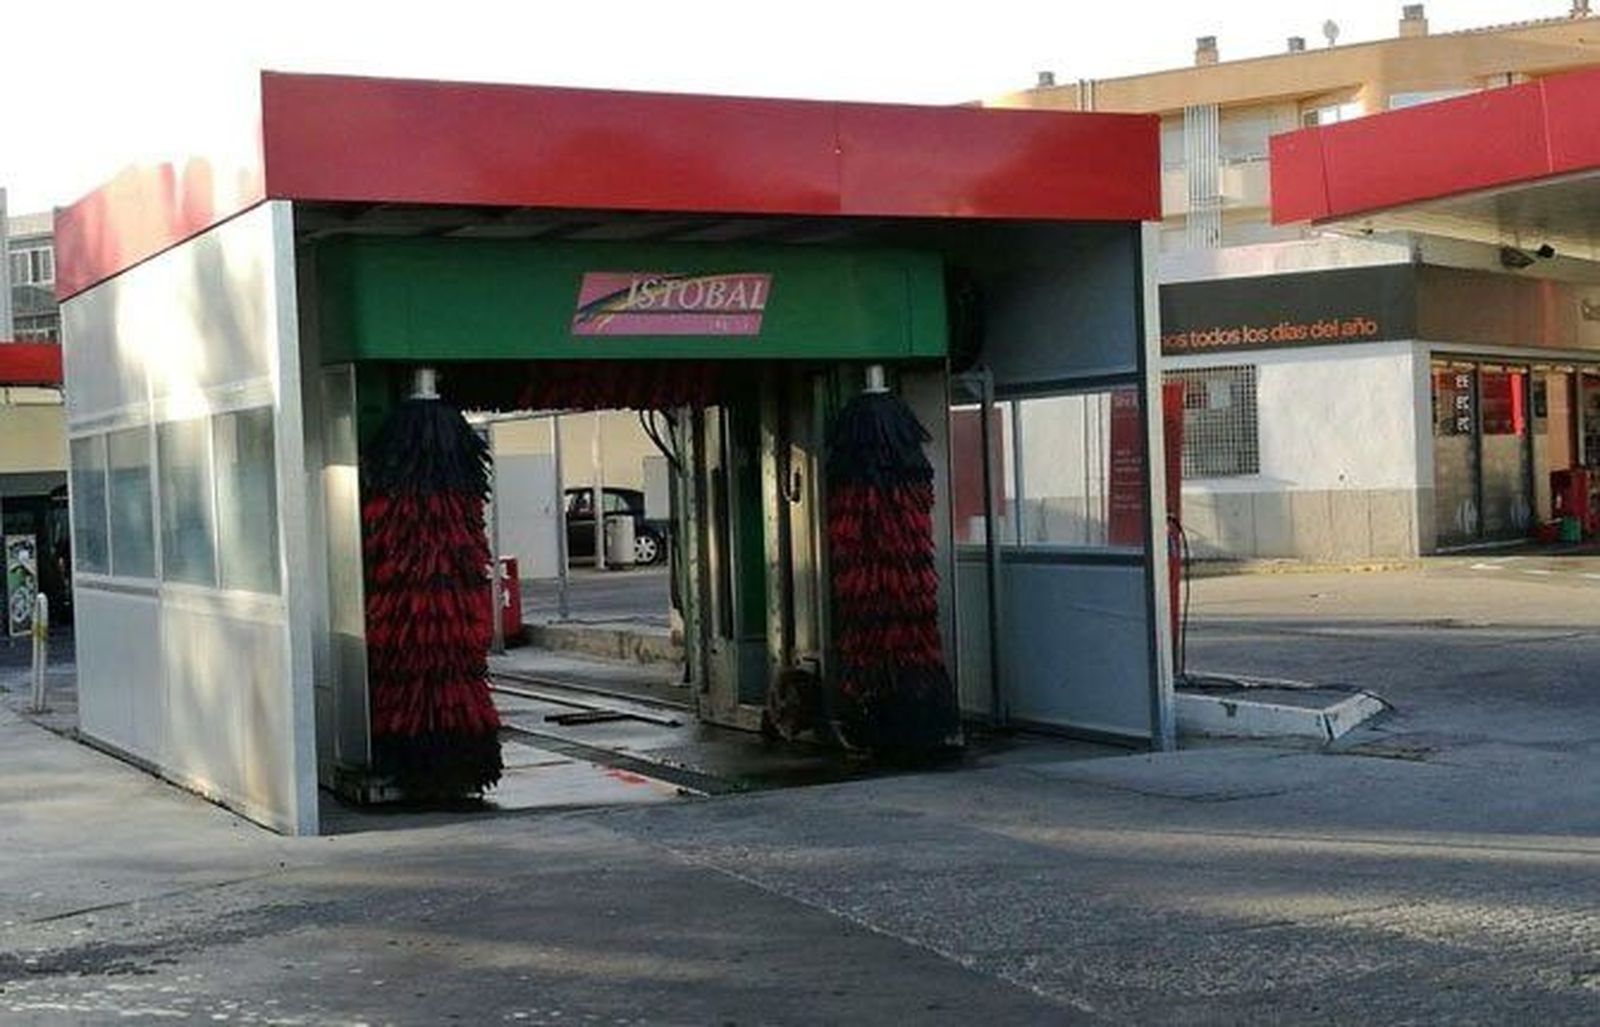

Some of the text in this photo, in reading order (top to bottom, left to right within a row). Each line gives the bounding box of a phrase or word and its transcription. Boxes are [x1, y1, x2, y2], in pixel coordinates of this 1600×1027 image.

[627, 277, 765, 309] ISTOBAL
[1190, 327, 1240, 347] todos
[1241, 325, 1268, 342] los
[1311, 319, 1338, 338] del
[1342, 317, 1377, 336] año
